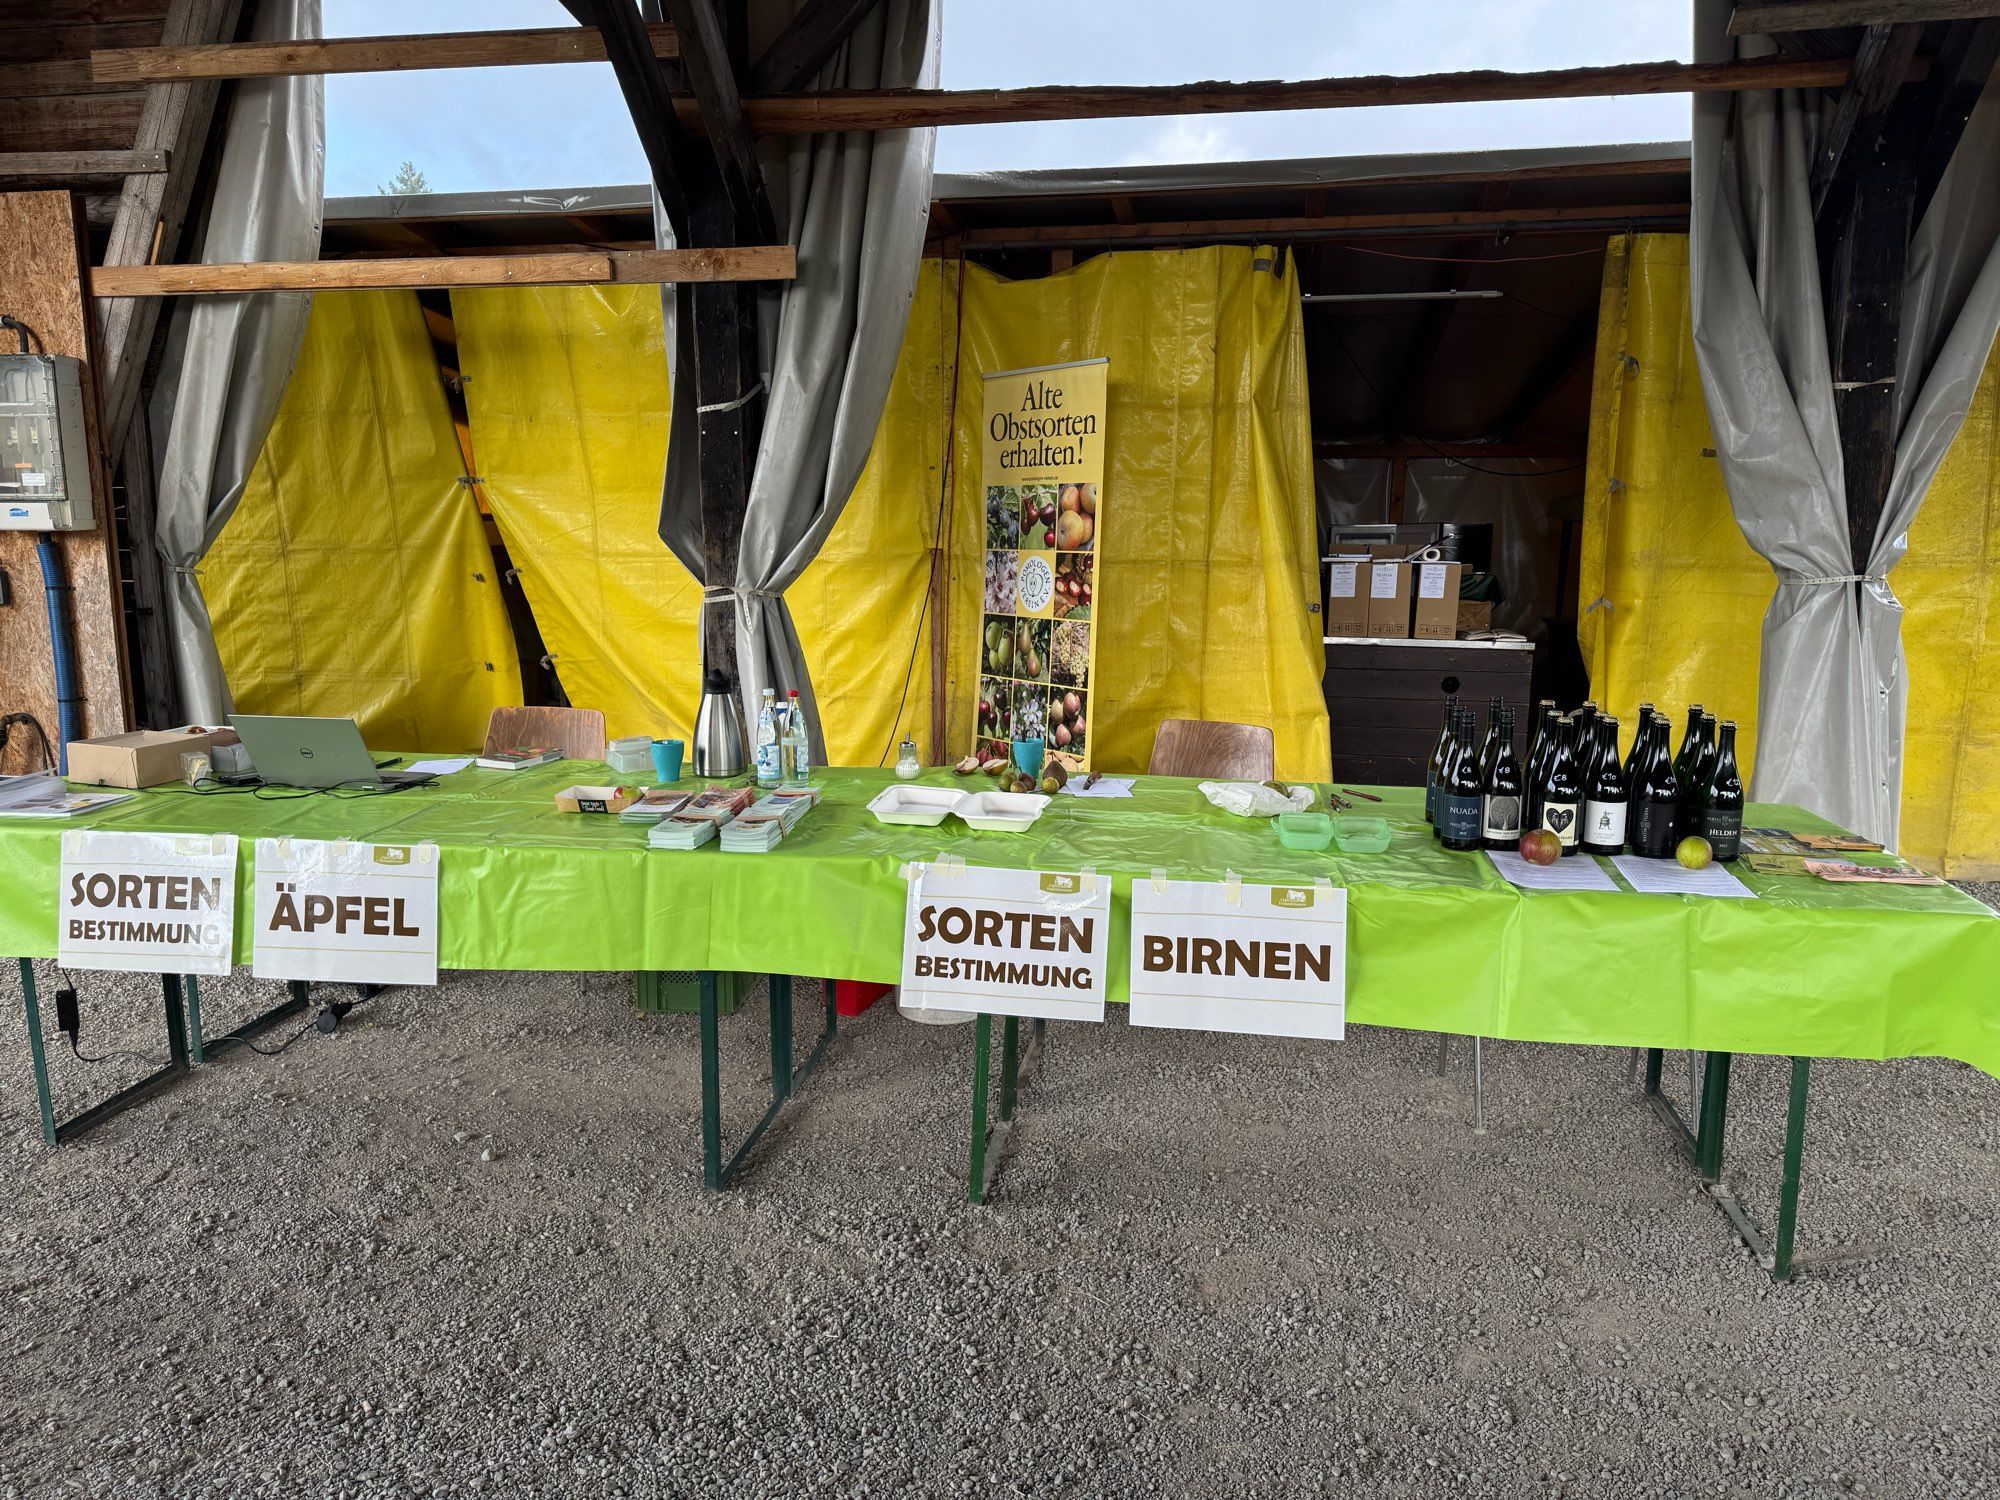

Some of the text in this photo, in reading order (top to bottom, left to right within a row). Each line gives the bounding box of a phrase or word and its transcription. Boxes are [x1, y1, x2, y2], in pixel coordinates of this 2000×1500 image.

[1021, 380, 1063, 412] Alte
[990, 412, 1097, 442] Obstsorten
[1000, 436, 1084, 469] erhalten!
[1021, 559, 1051, 584] POMOLOGEN
[1021, 587, 1040, 608] VEREIN
[1553, 774, 1567, 782] €8
[1602, 773, 1617, 781] €10
[1449, 806, 1478, 815] NUADA
[1709, 828, 1738, 836] HELDEN
[70, 872, 221, 911] SORTEN
[269, 882, 420, 936] ÄPFEL
[69, 919, 220, 945] BESTIMMUNG
[918, 905, 1094, 954] SORTEN
[914, 955, 1093, 990] BESTIMMUNG
[1143, 934, 1332, 982] BIRNEN
